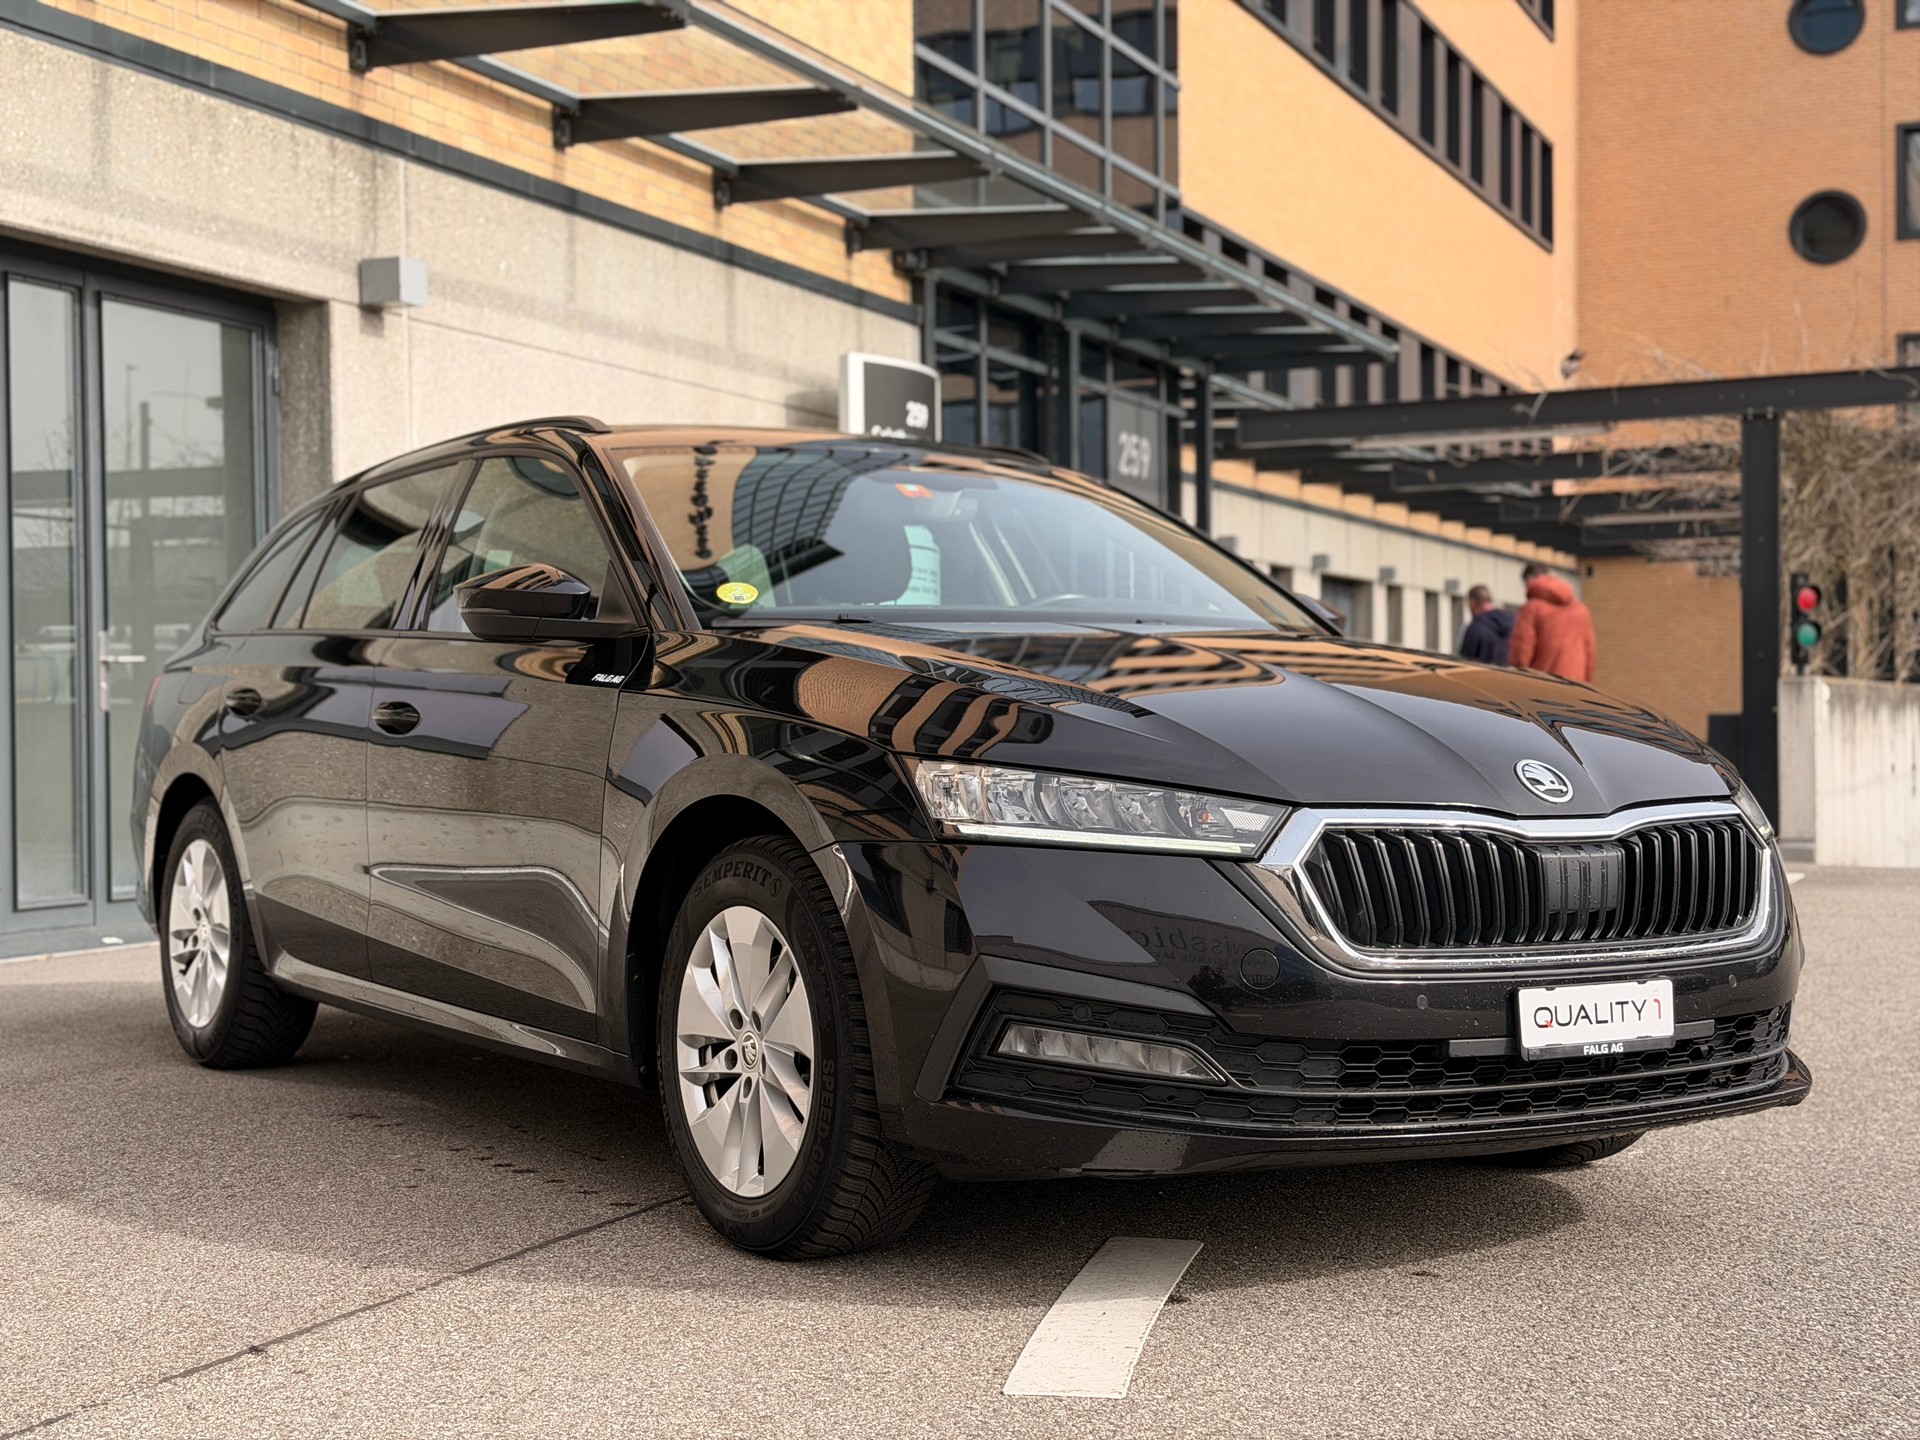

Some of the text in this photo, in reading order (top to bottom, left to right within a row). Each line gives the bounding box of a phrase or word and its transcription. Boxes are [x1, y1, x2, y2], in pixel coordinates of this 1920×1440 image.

[591, 673, 625, 684] FALG AG
[694, 860, 773, 899] SEMPERIT
[1583, 1042, 1624, 1056] FALG AG
